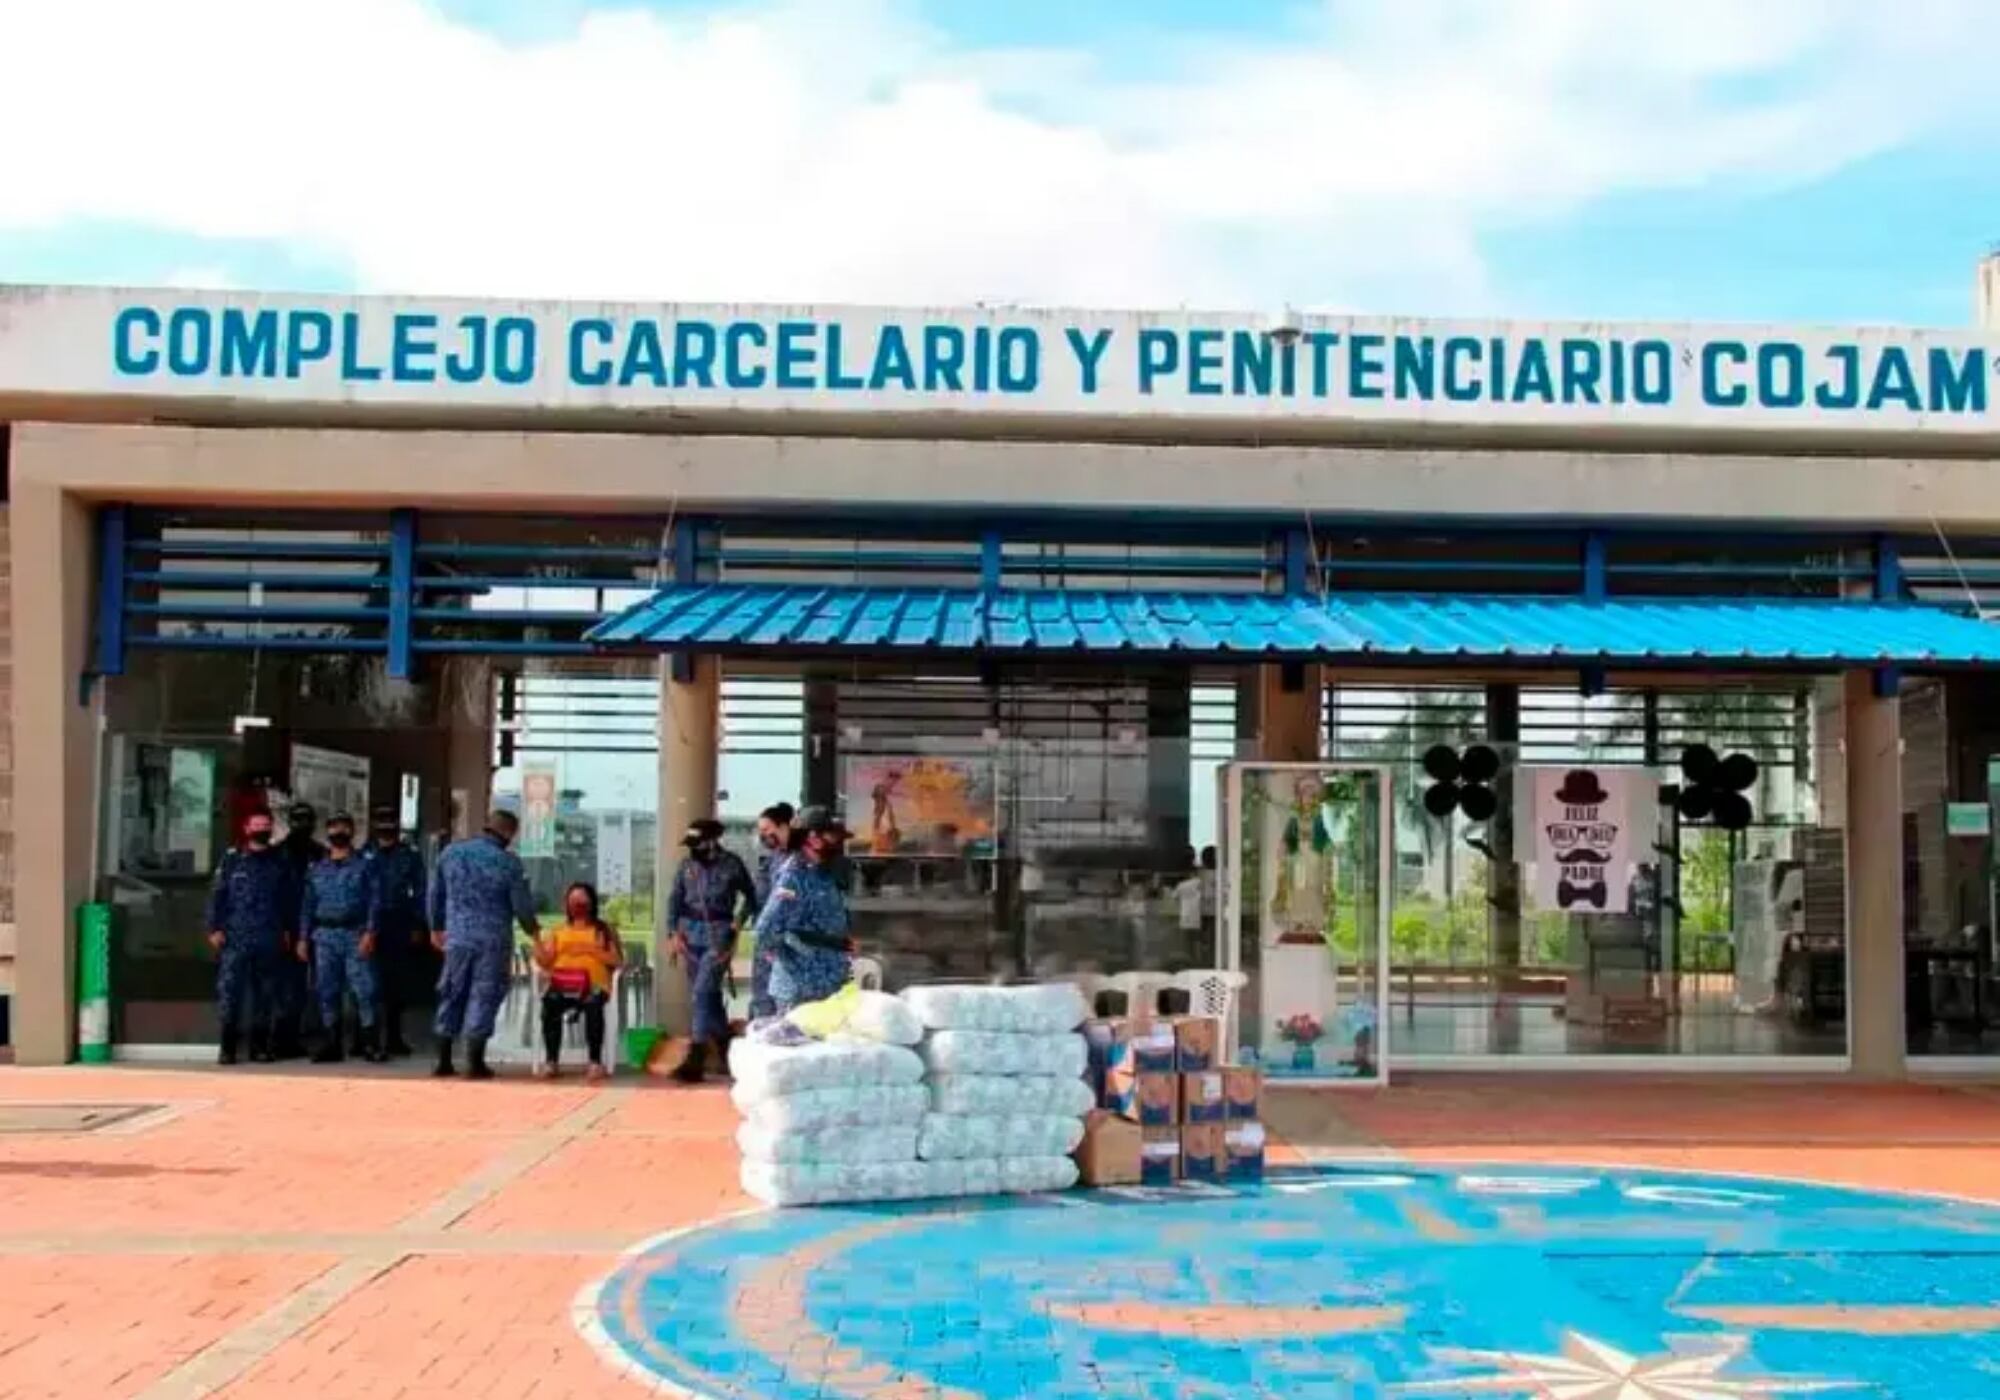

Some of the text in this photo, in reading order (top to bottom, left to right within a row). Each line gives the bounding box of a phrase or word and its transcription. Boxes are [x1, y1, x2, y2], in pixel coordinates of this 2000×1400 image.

[114, 306, 1987, 412] COMPLEJO CARCELARIO Y PENITENCIARIO COJAM
